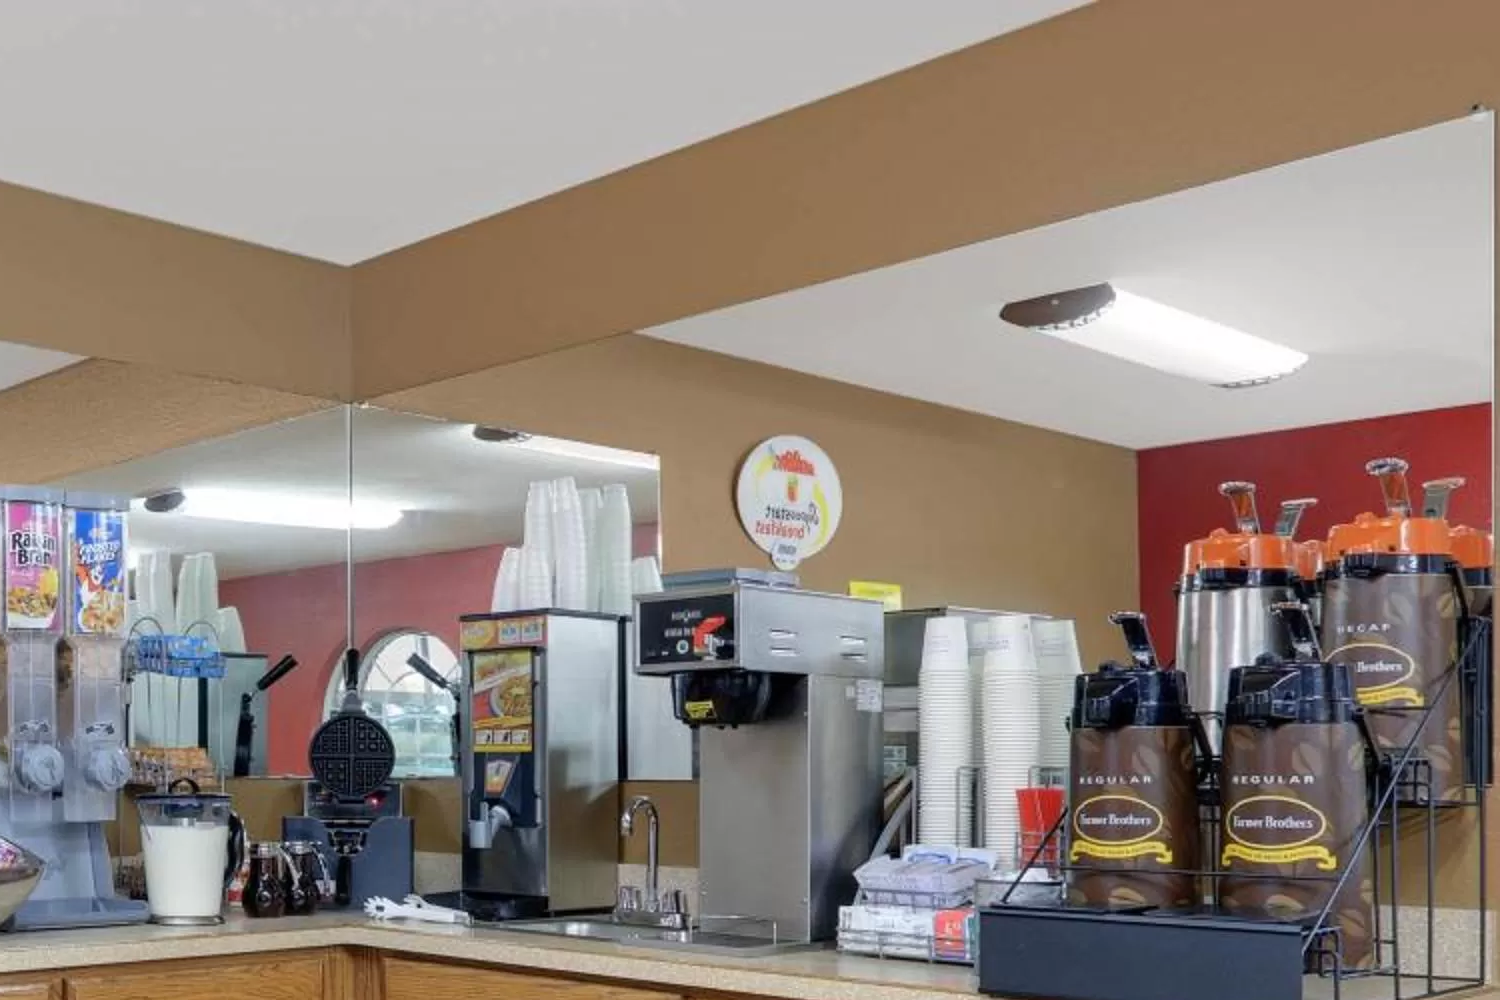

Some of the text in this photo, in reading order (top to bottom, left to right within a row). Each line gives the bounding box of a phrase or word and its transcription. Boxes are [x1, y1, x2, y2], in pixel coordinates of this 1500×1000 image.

[18, 548, 52, 565] Bran
[1079, 775, 1153, 786] REGULAR
[1232, 775, 1316, 786] REGULAR
[1108, 813, 1153, 827] Brothers
[1265, 815, 1315, 831] Brothers
